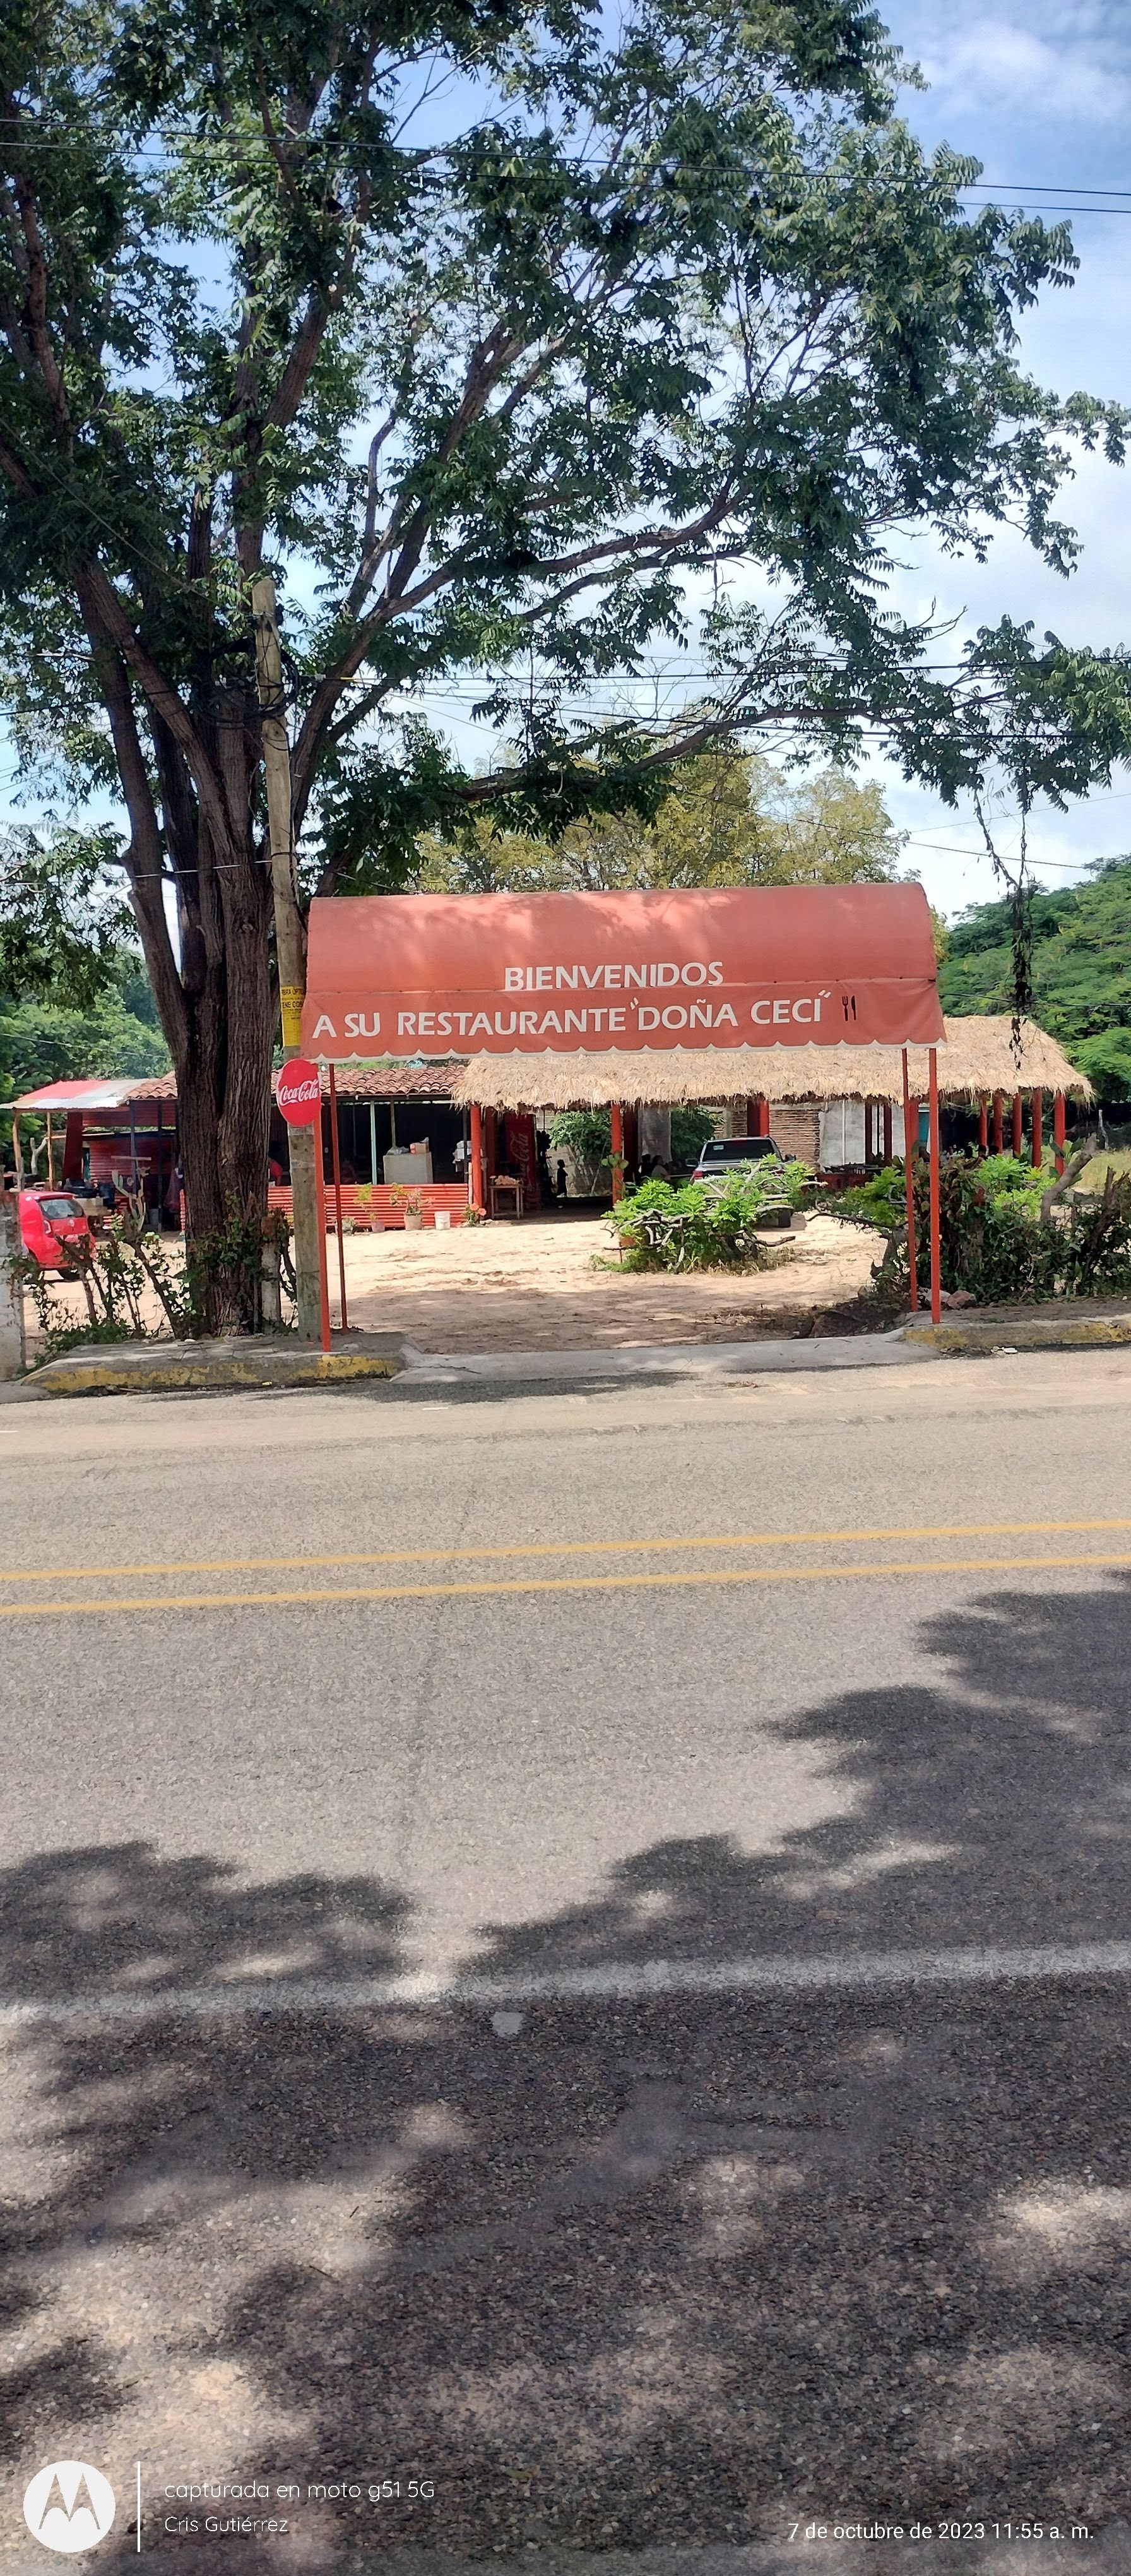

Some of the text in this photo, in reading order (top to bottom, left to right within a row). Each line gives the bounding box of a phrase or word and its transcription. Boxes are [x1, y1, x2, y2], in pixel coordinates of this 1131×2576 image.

[504, 961, 723, 991] BIENVENIDOS
[312, 1015, 336, 1038] A
[345, 1012, 380, 1037] SU
[398, 1008, 625, 1036] RESTAURANTE
